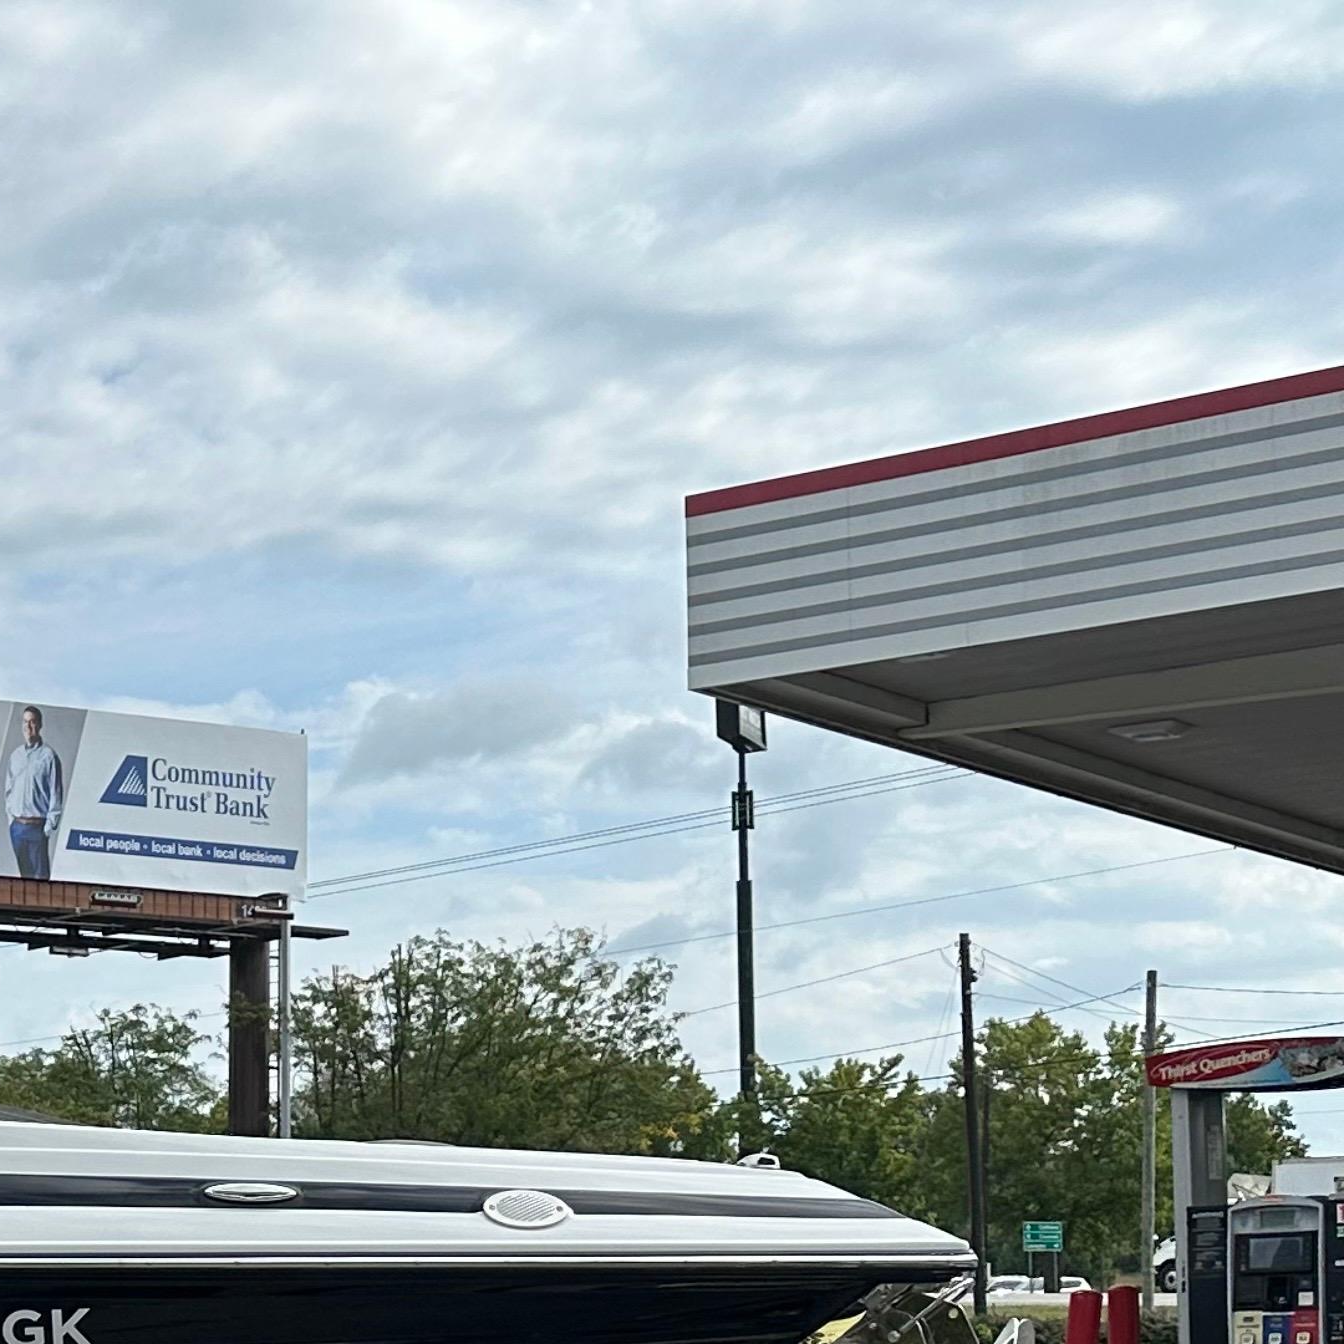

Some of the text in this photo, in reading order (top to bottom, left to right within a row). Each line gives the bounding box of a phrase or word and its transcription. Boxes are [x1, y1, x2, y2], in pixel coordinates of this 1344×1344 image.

[151, 758, 276, 798] Community
[215, 792, 269, 819] Bank
[79, 833, 286, 865] local people local bank local decisions
[1159, 1049, 1271, 1080] Thirst Quenchers
